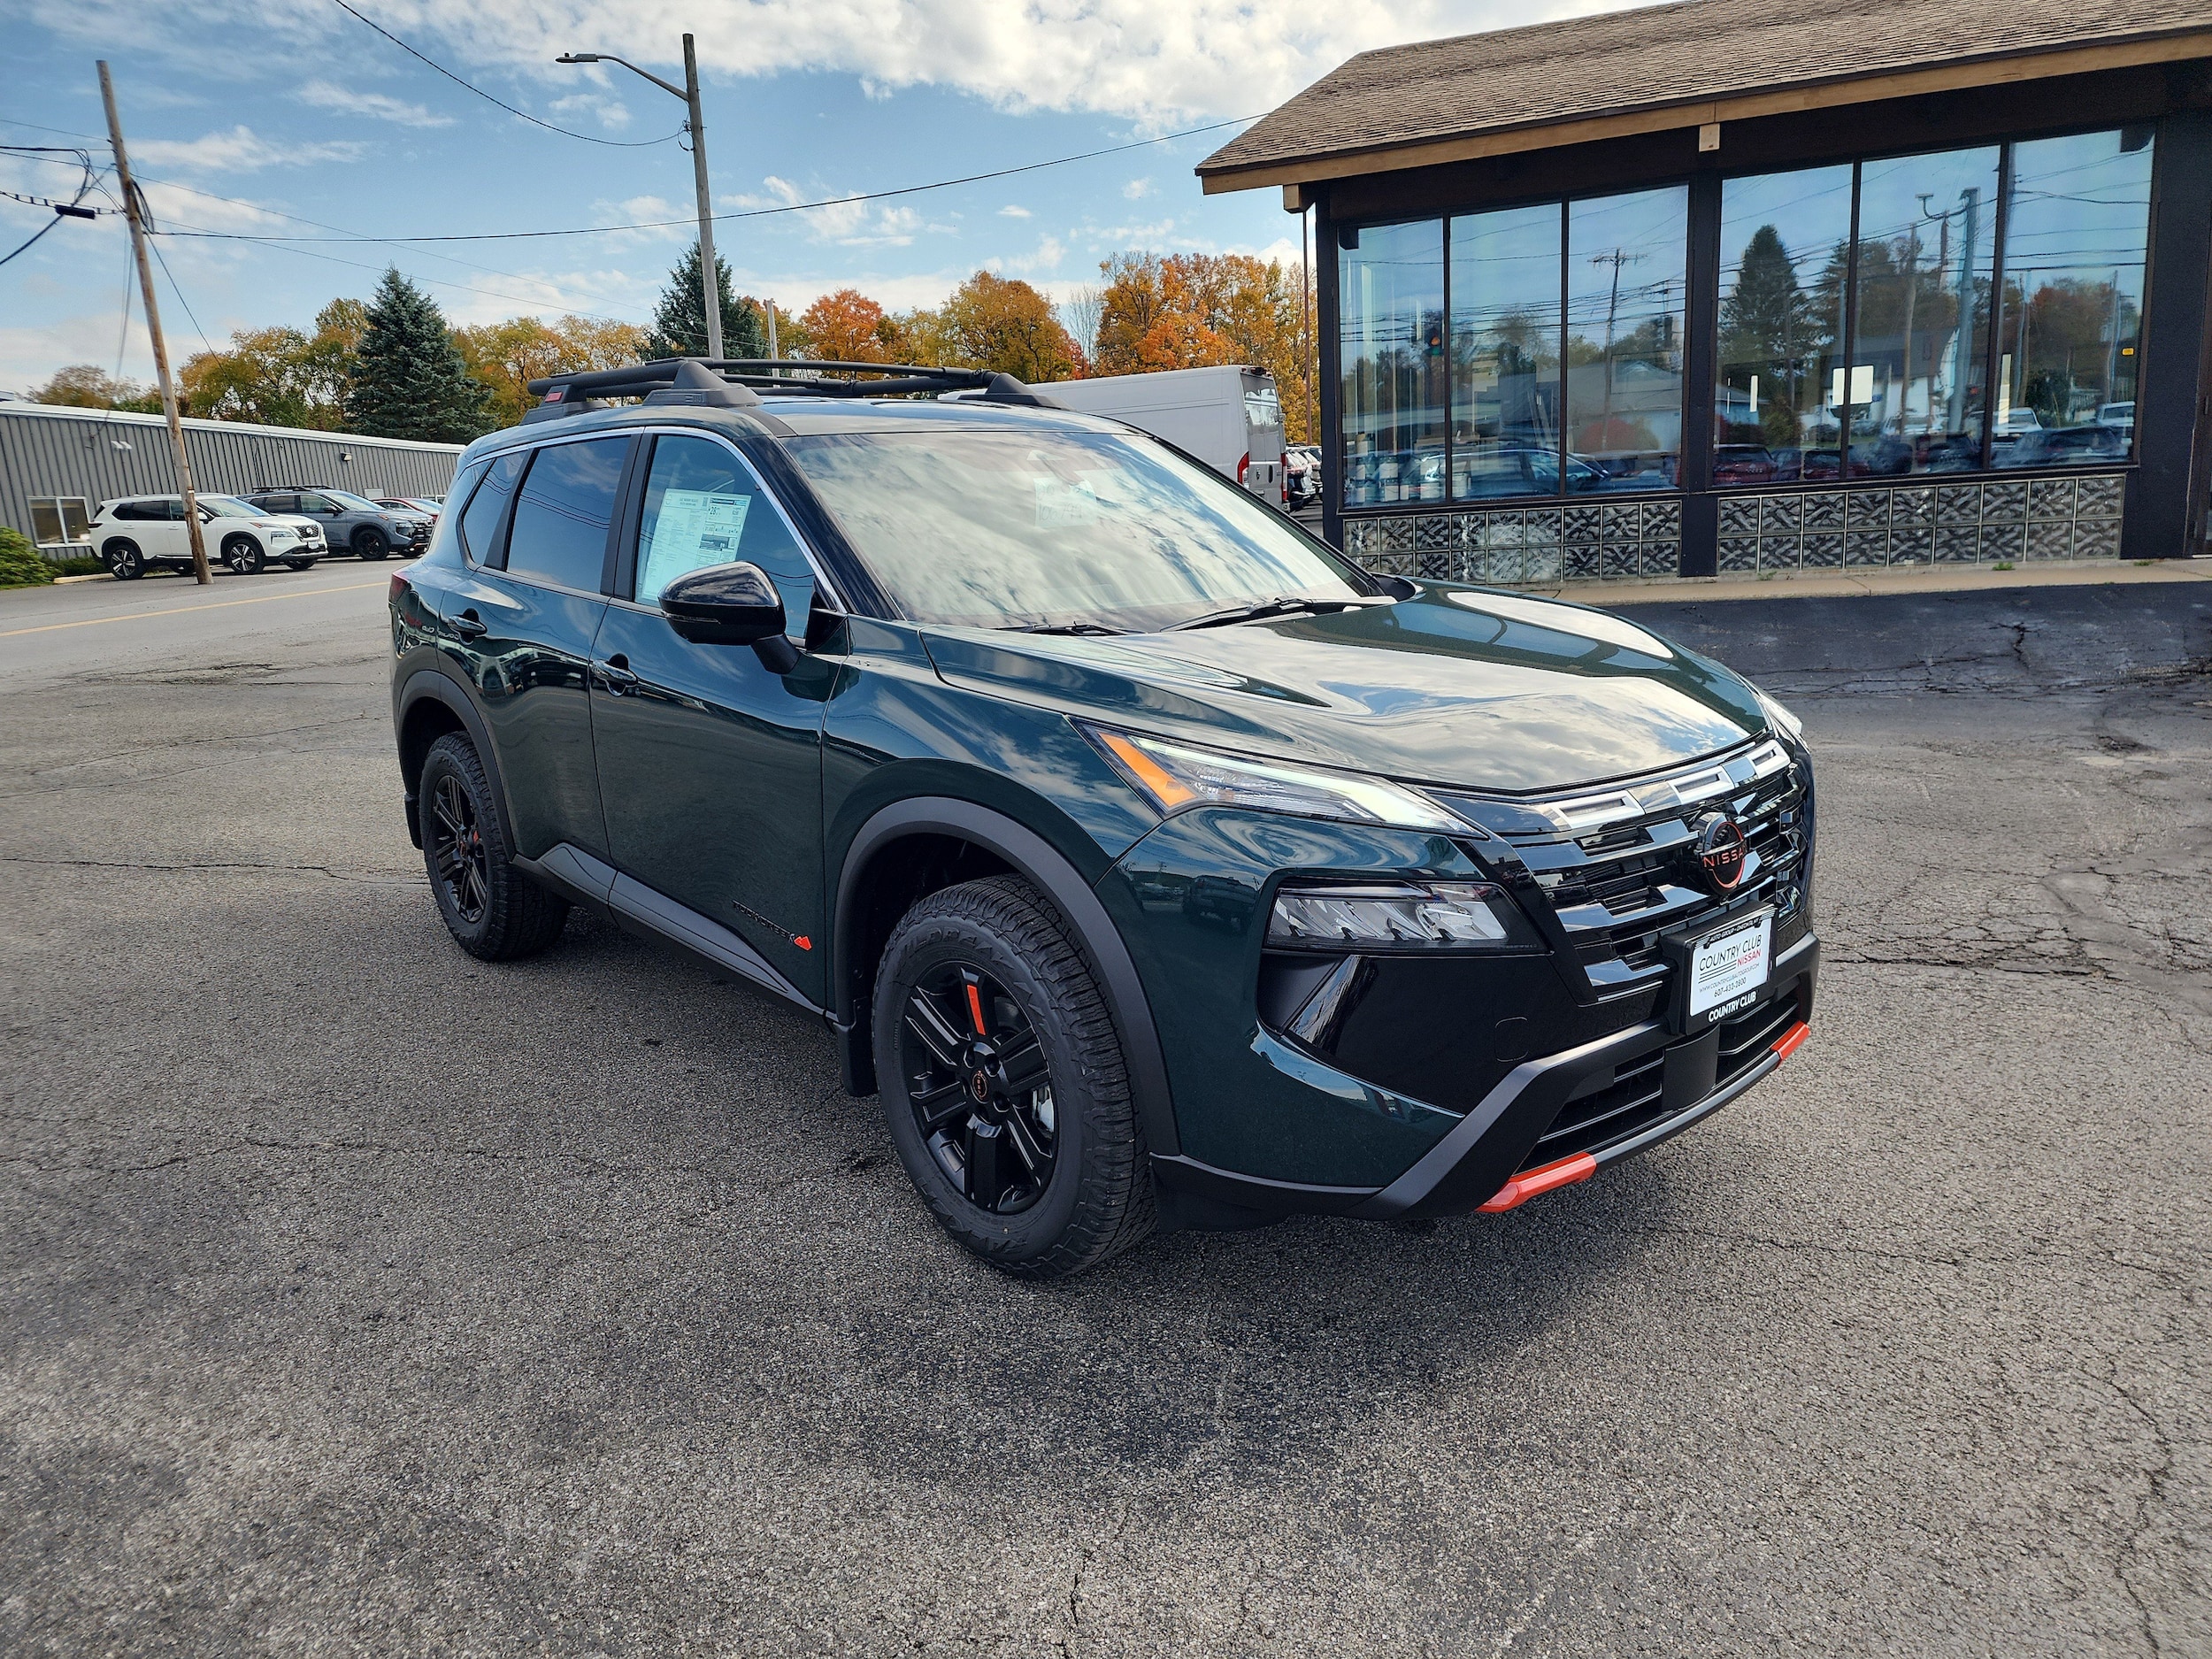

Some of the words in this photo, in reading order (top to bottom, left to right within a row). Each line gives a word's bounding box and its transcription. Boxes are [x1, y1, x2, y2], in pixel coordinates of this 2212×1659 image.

[1699, 942, 1741, 972] COUNTRY
[1742, 934, 1762, 953] CLUB
[1737, 949, 1762, 966] NISSAN
[1714, 977, 1747, 997] 607-432-2800
[1709, 998, 1740, 1023] COUNTRY
[1740, 990, 1757, 1008] CLUB
